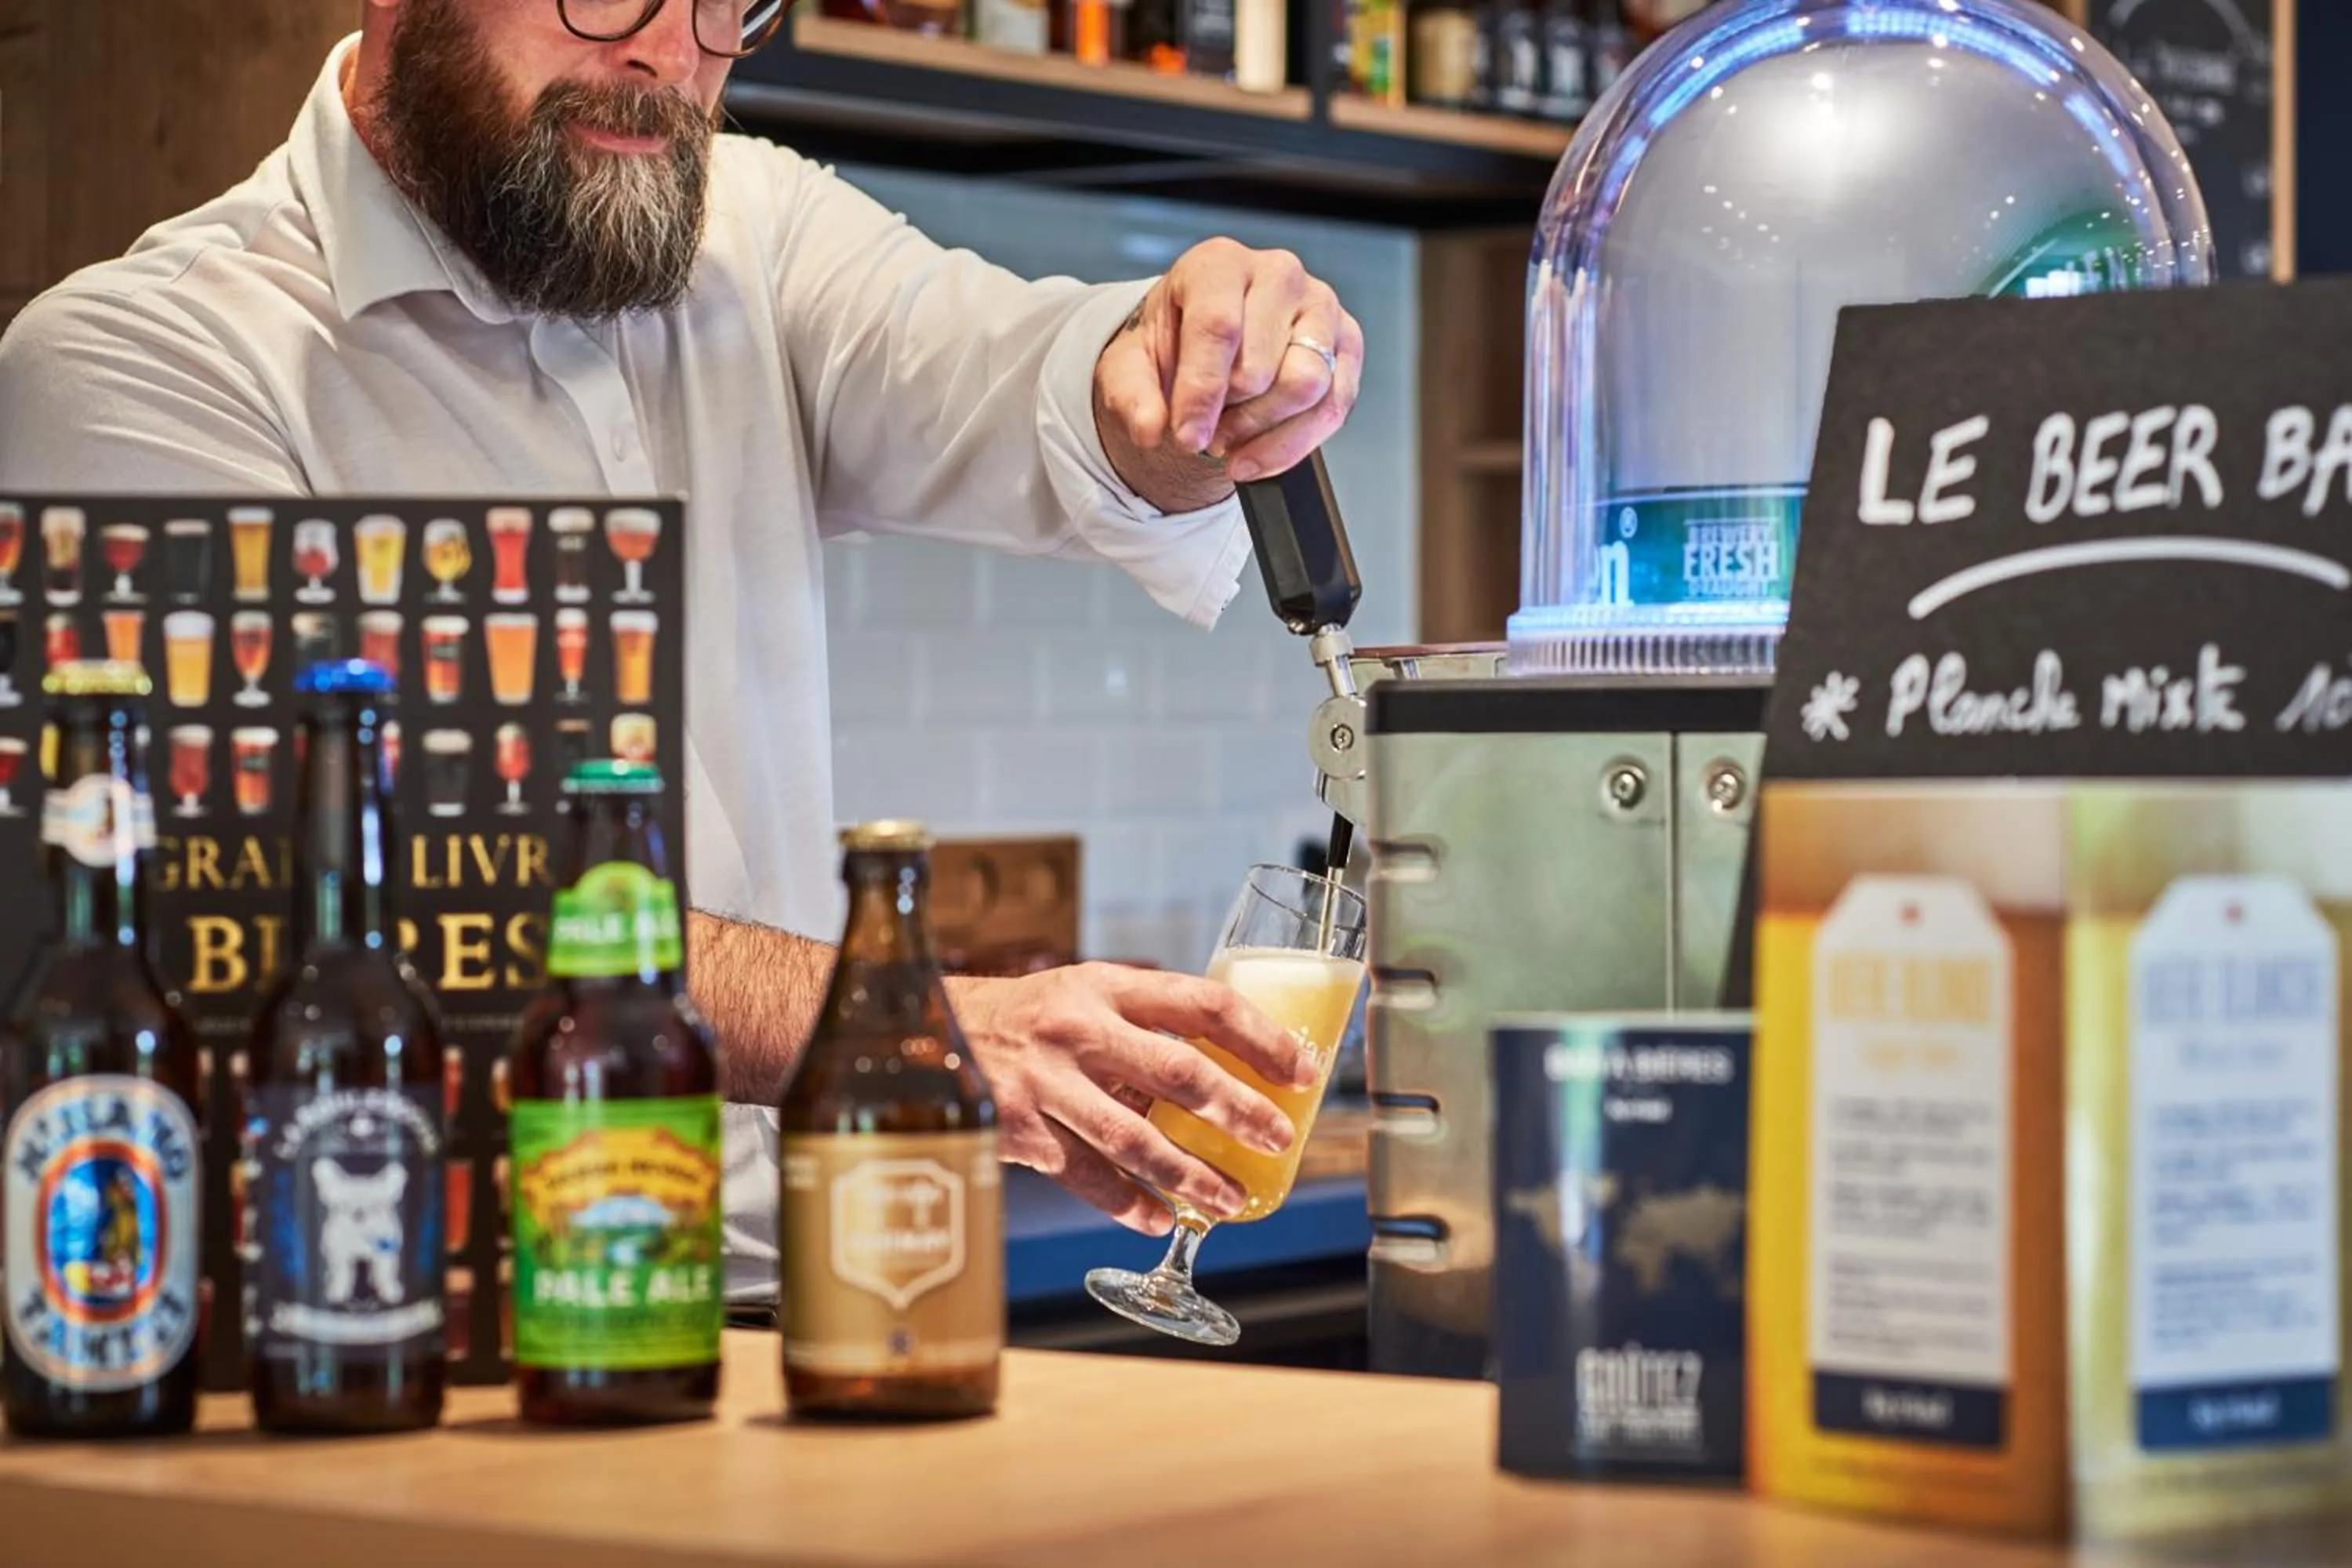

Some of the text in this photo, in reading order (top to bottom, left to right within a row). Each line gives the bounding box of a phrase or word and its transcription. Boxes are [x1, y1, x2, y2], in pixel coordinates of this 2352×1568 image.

[1858, 416, 1990, 524] LE
[2025, 404, 2223, 523] BEER
[1682, 543, 1779, 580] FRESH
[152, 833, 554, 892] GRA LIVR
[532, 1264, 713, 1308] PALE ALE
